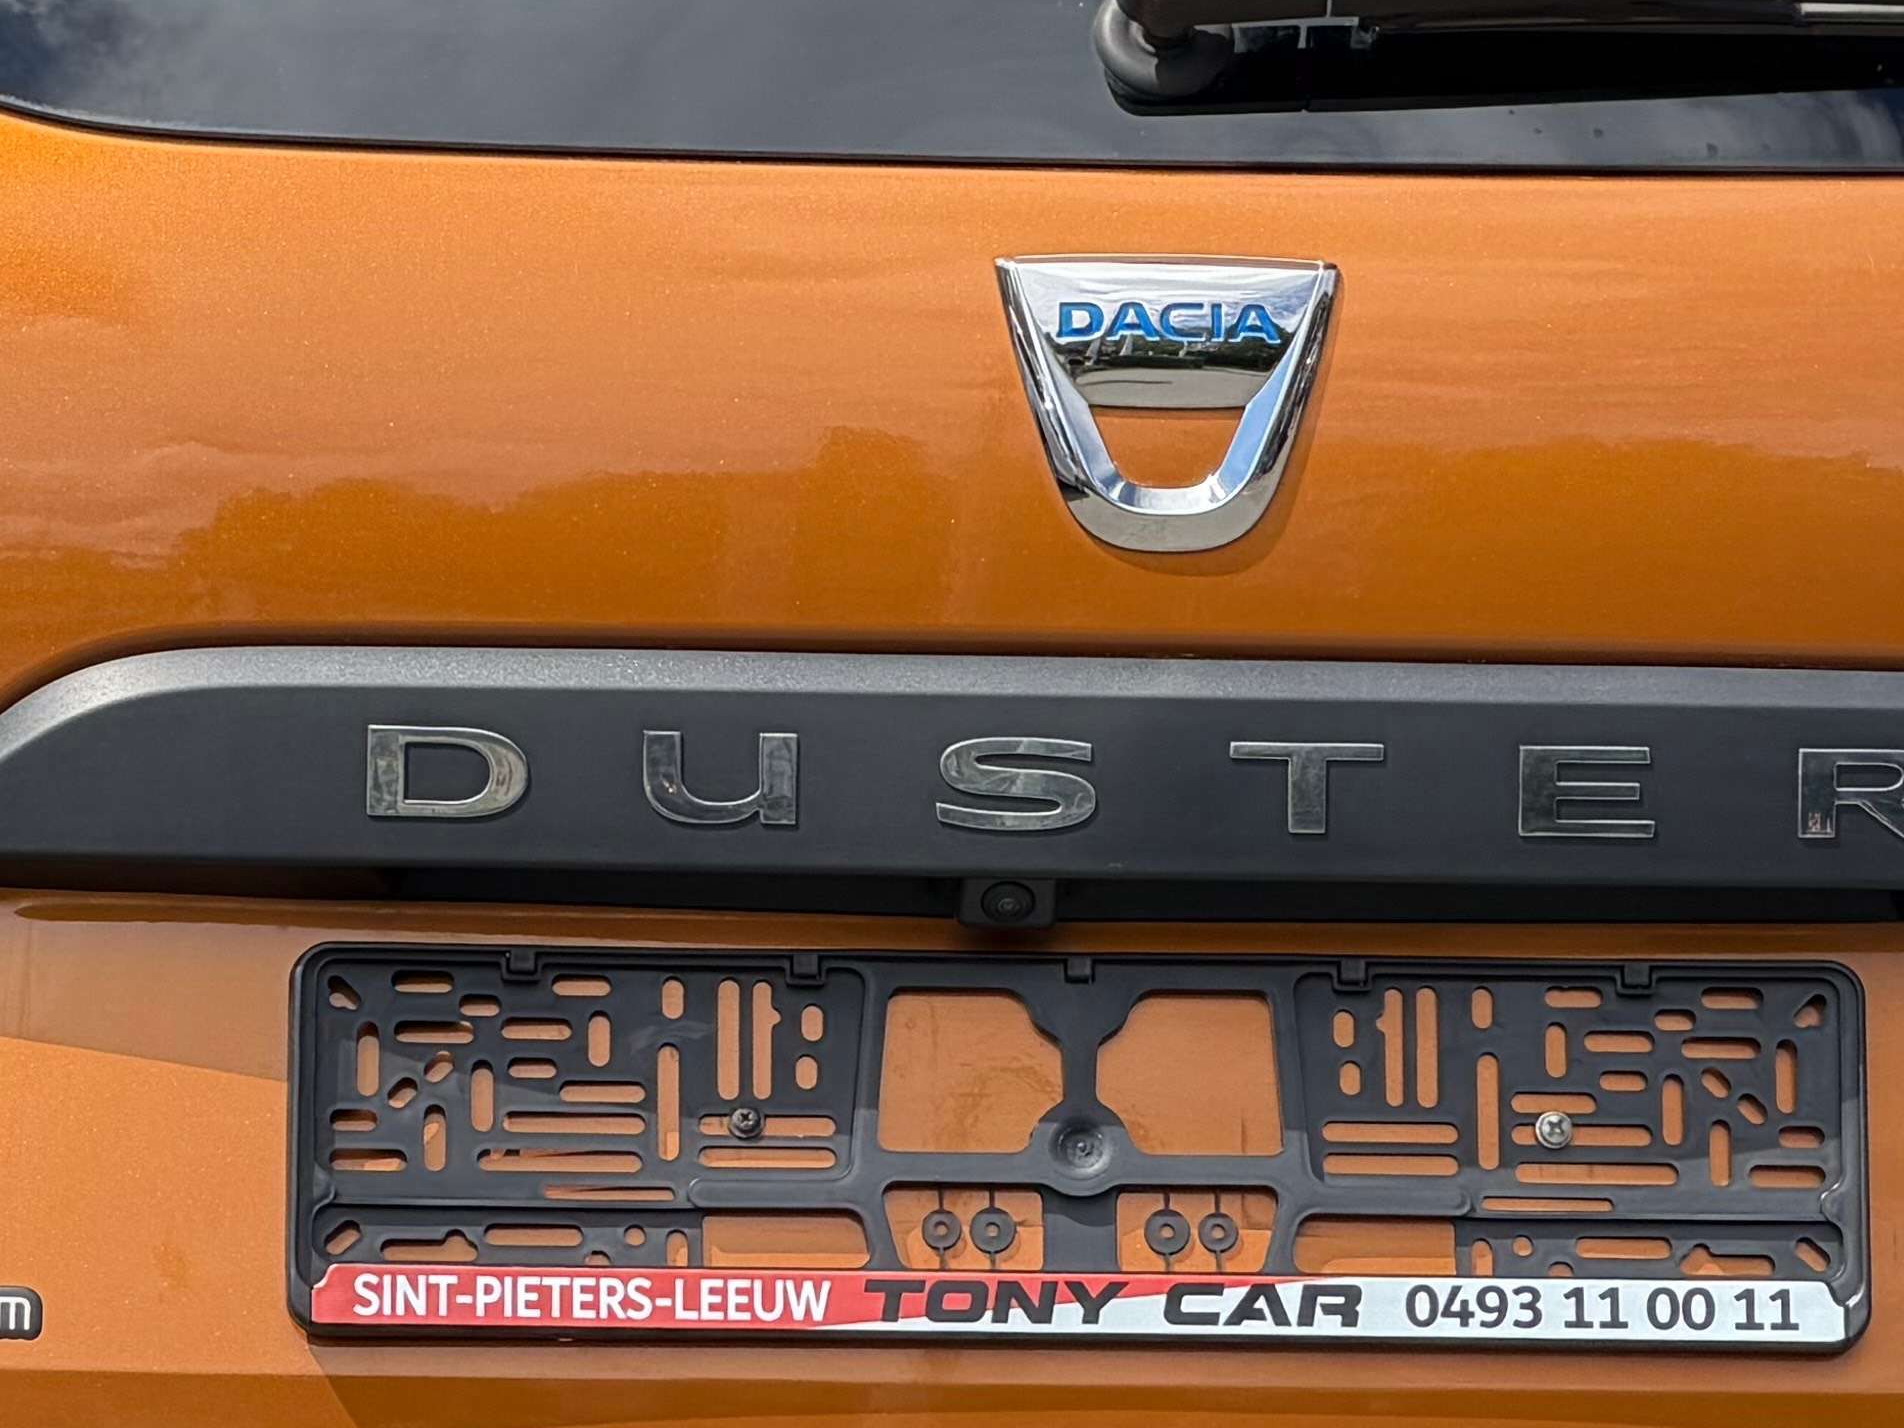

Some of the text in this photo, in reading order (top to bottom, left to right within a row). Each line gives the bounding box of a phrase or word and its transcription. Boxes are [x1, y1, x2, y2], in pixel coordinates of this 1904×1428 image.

[1056, 301, 1282, 344] DACIA
[352, 1273, 1800, 1331] SINT-PIETERS-LEEUW TONY CAR 0493 11 00 11
